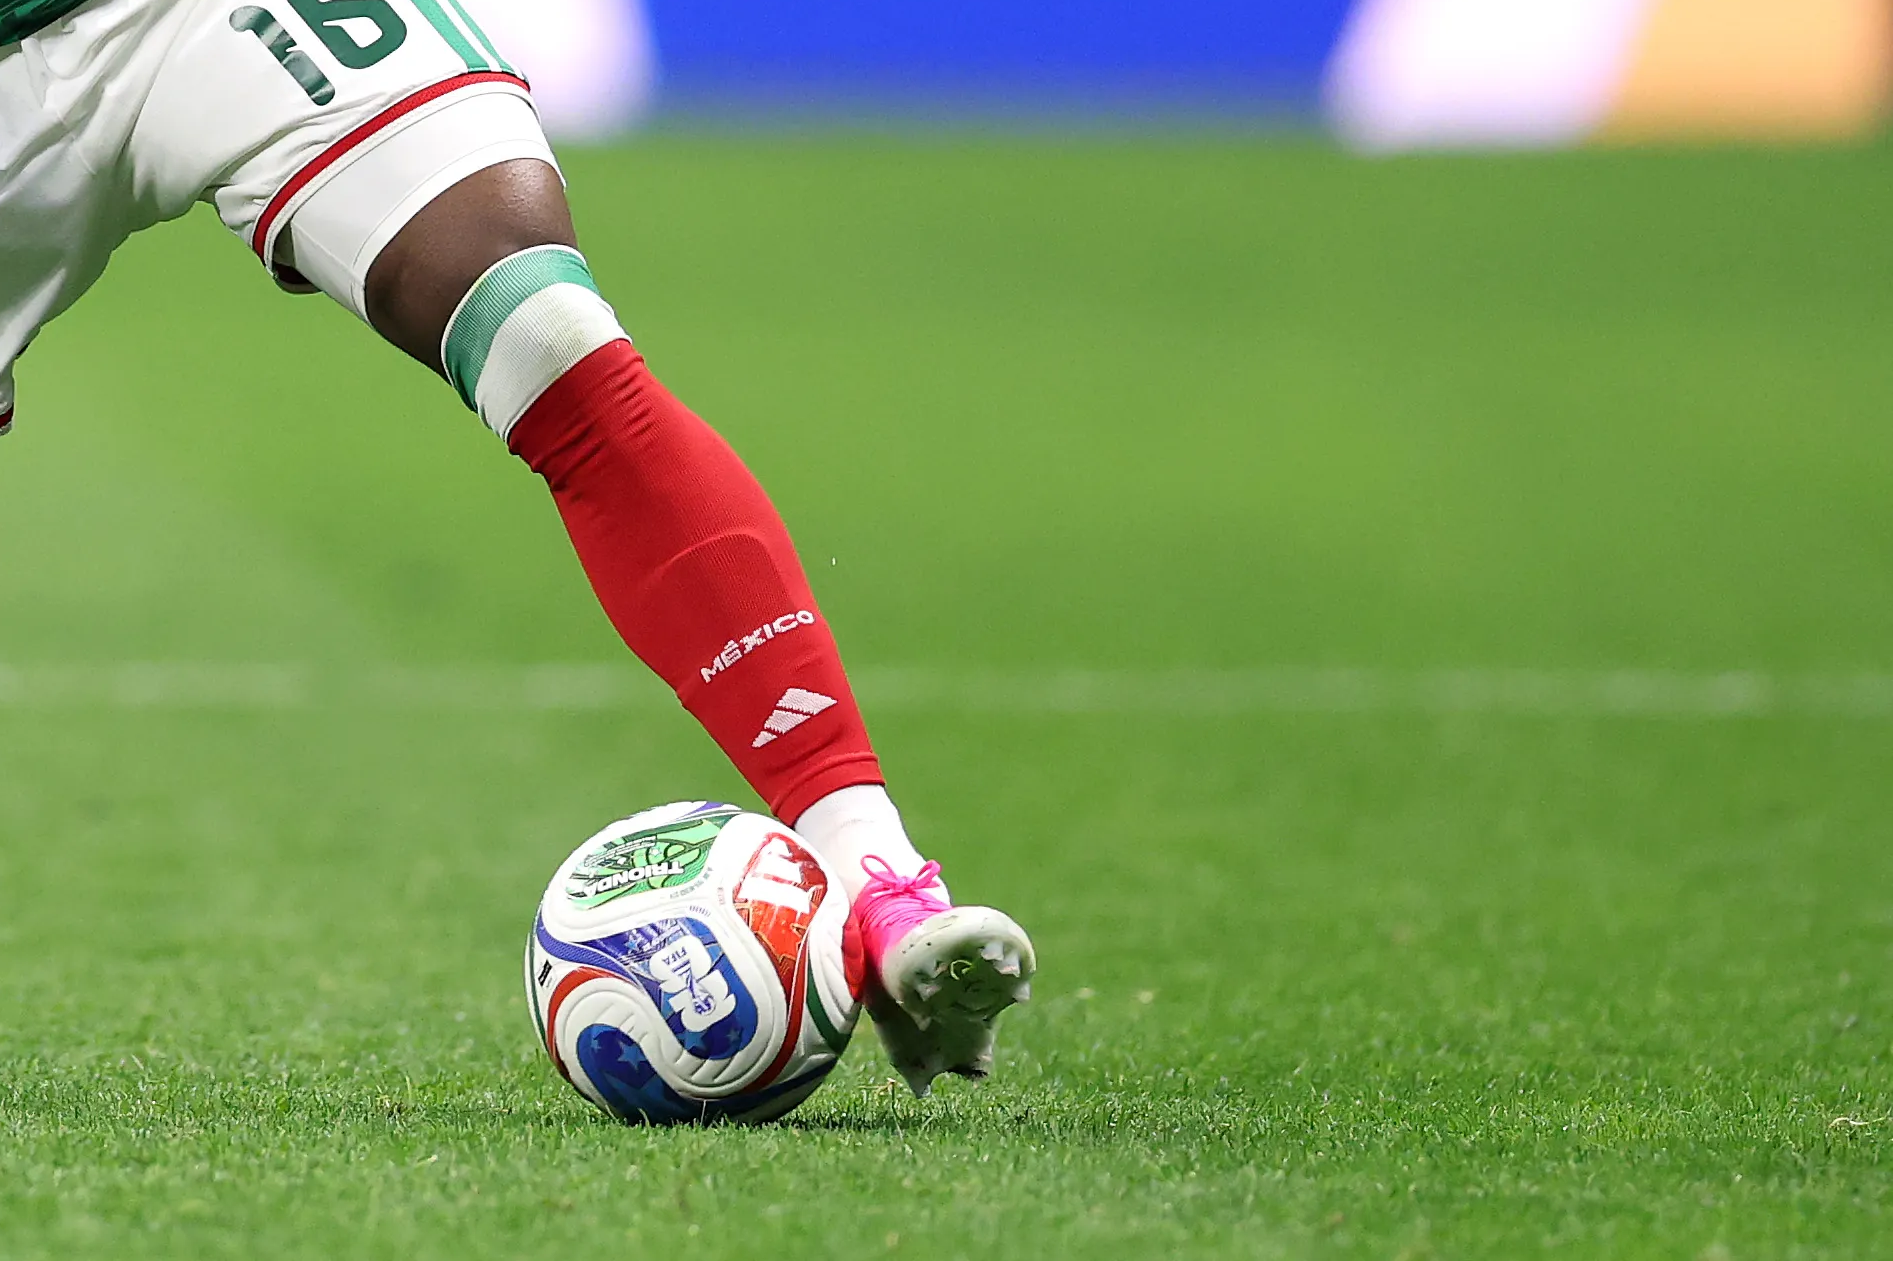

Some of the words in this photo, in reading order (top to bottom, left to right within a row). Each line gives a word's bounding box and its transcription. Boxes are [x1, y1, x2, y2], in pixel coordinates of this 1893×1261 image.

[700, 610, 816, 684] MÉXICO
[580, 860, 685, 899] TRIONDA
[661, 946, 688, 966] FIFA
